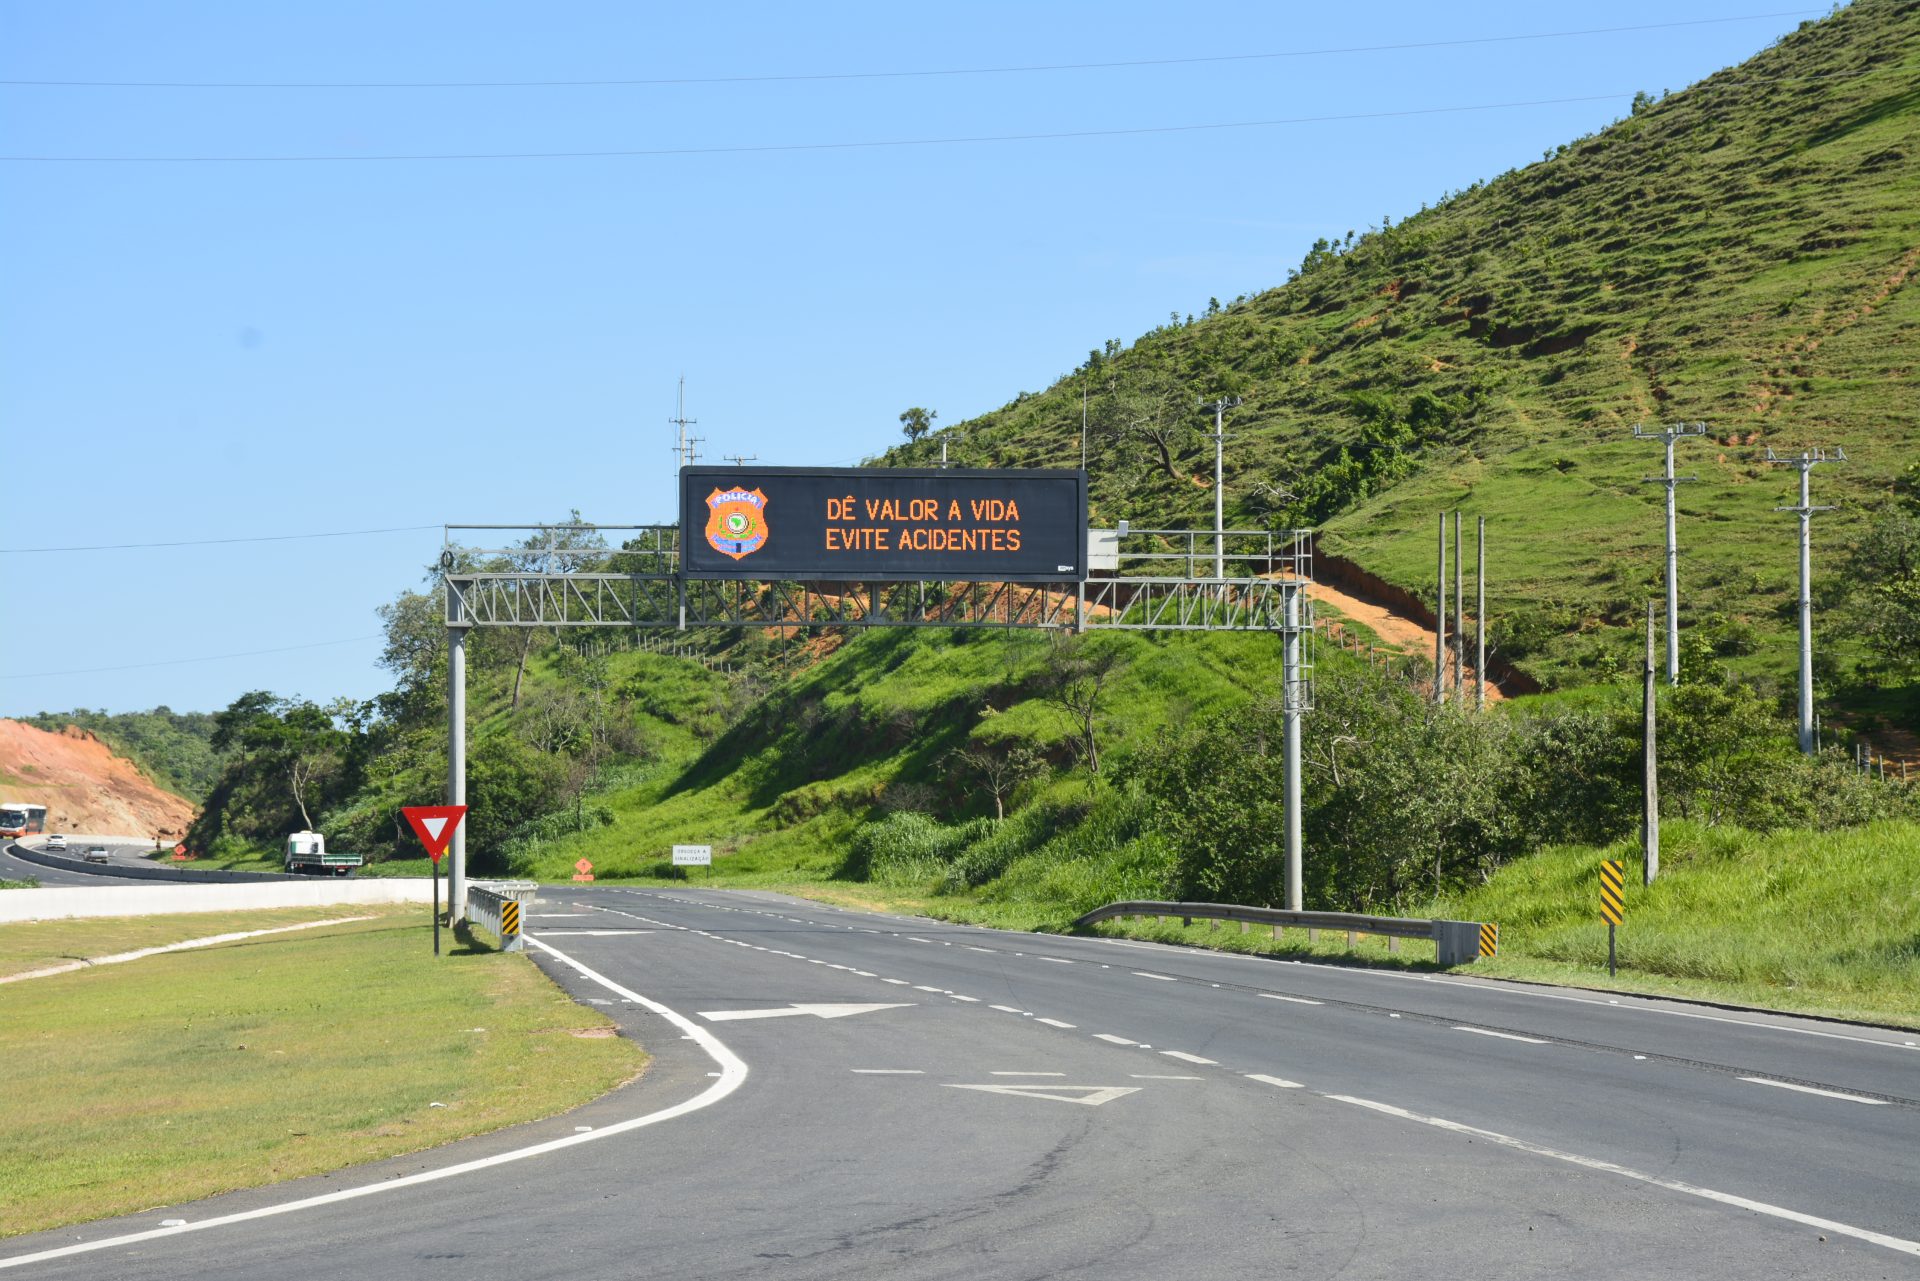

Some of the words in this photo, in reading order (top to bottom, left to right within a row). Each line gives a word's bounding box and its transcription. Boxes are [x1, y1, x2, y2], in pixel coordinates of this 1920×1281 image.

[827, 495, 856, 521] DÊ
[865, 499, 939, 521] VALOR
[948, 499, 962, 521] A
[970, 499, 1020, 521] VIDA
[826, 528, 889, 550] EVITE
[898, 528, 1021, 551] ACIDENTES
